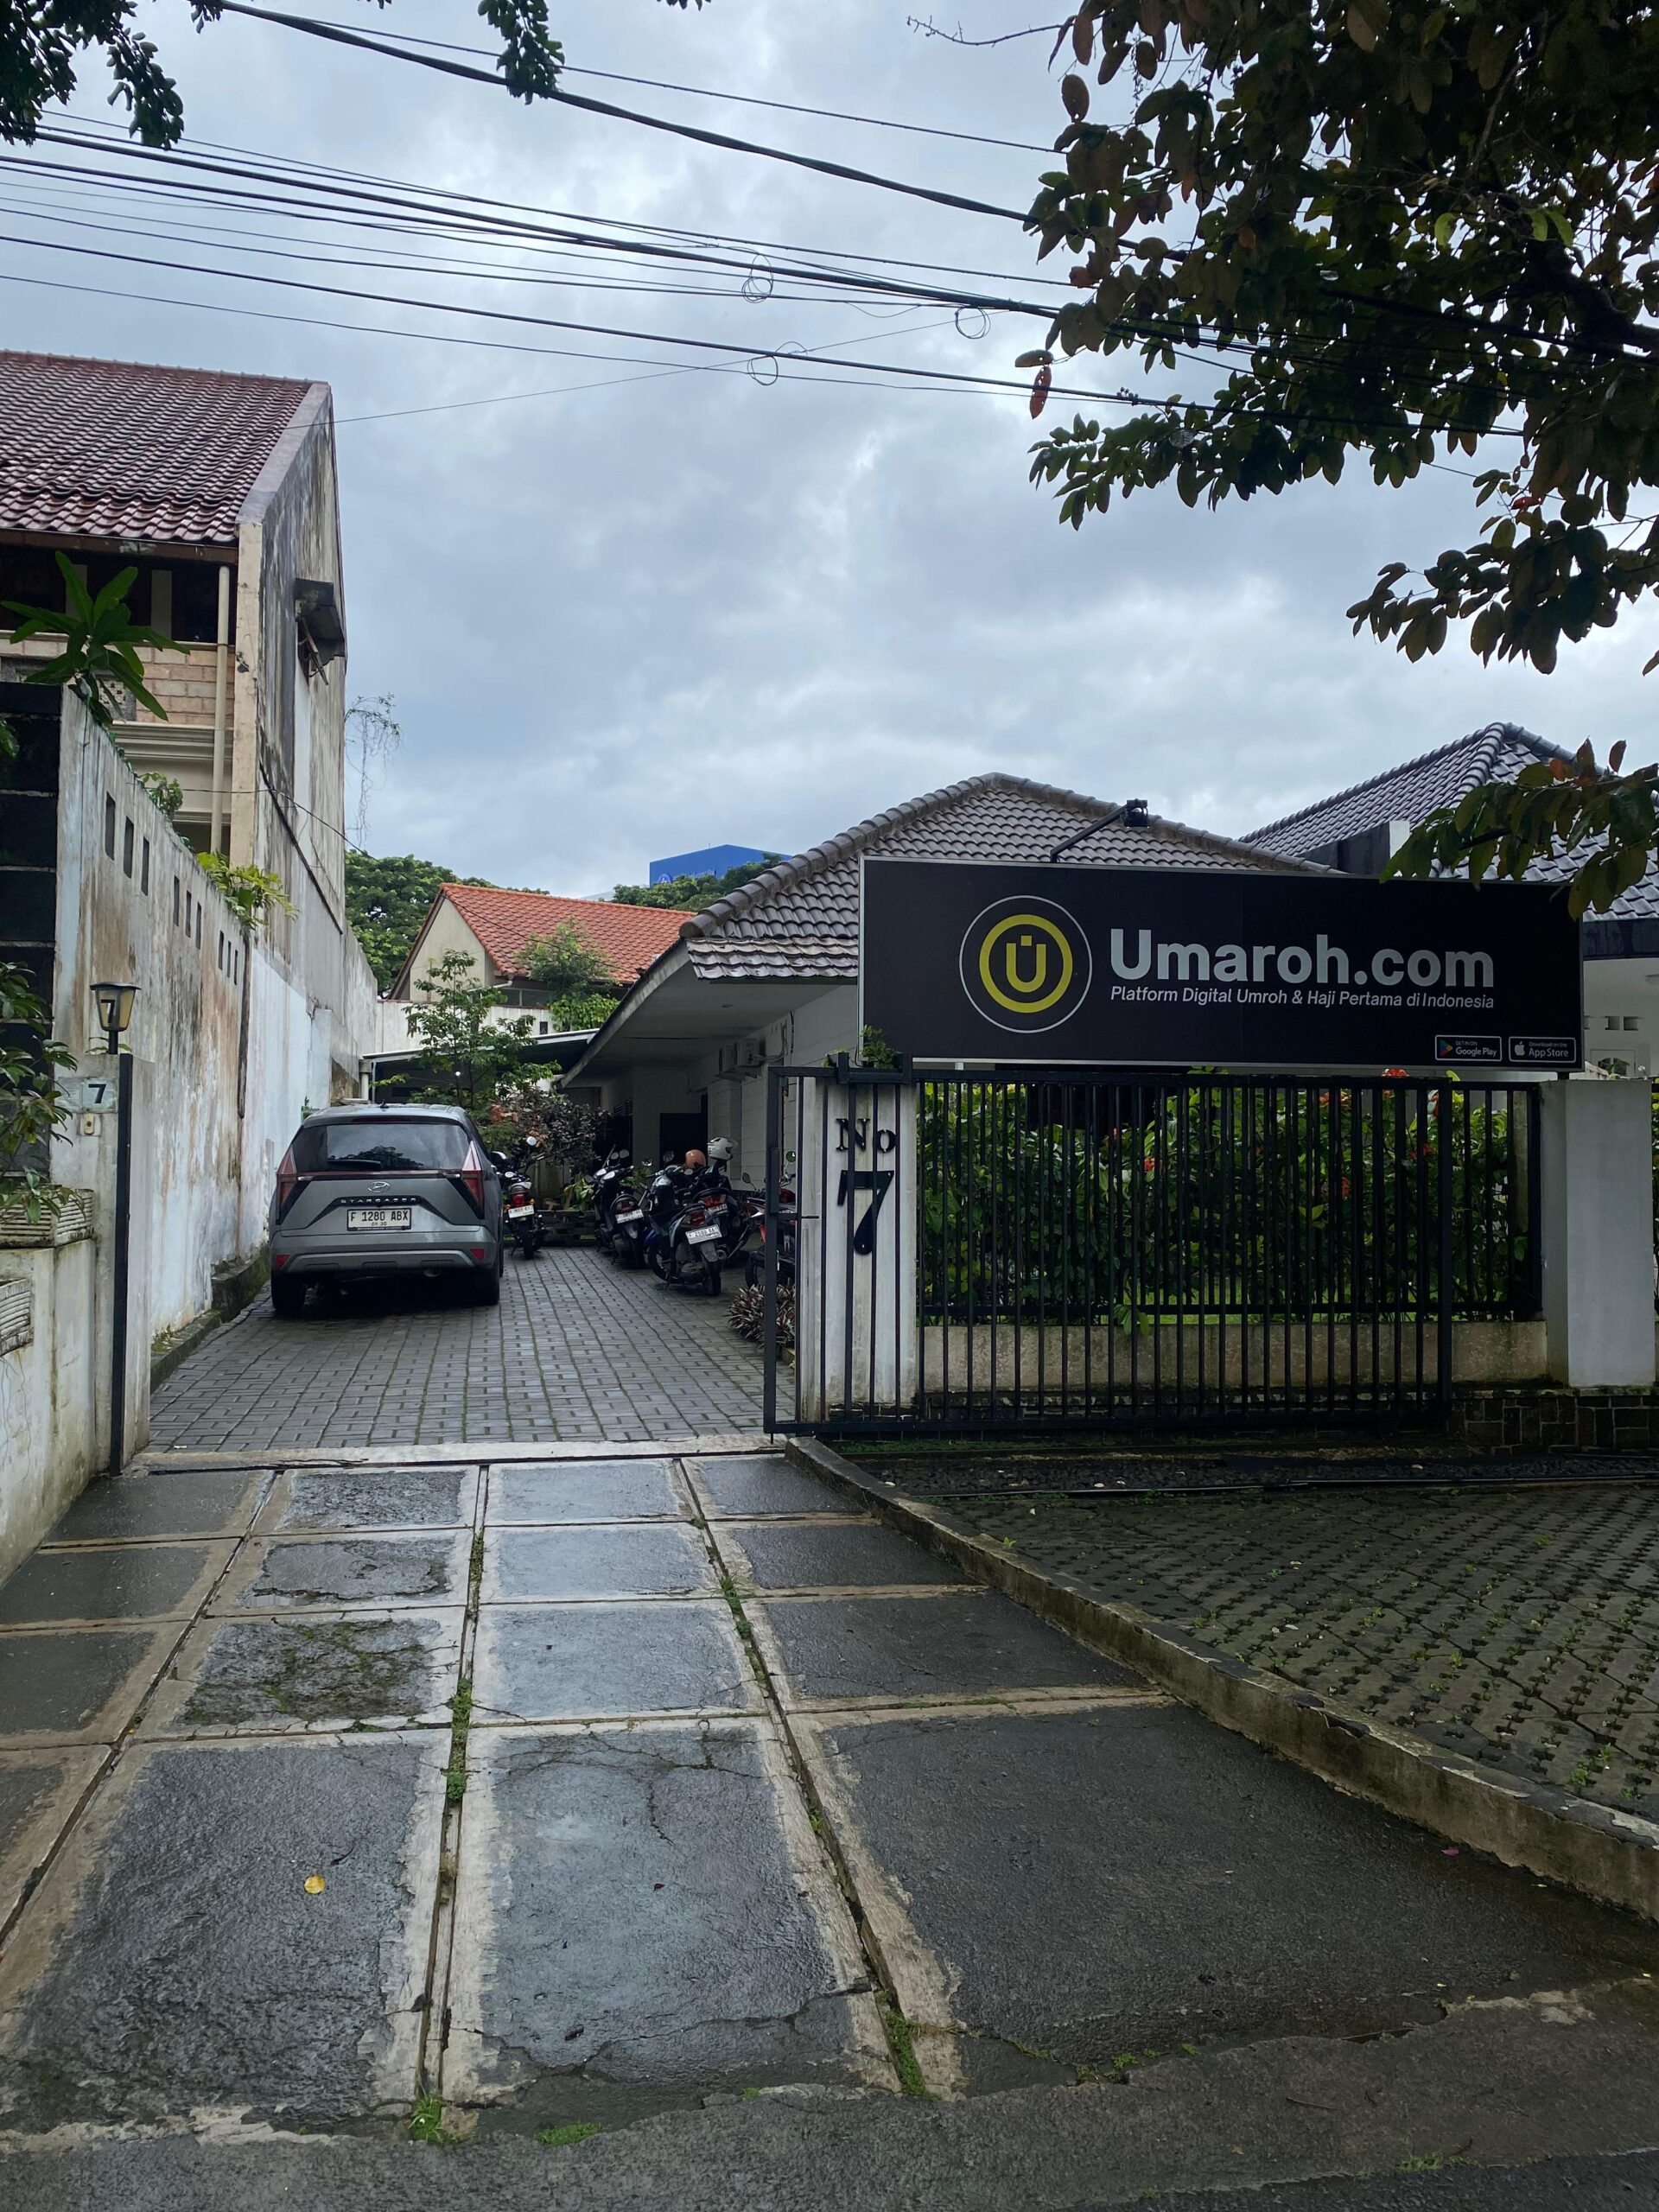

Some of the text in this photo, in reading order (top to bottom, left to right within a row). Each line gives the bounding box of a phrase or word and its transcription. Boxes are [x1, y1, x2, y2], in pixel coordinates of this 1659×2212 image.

[1110, 928, 1494, 988] Umaroh.com
[1110, 986, 1494, 1008] Platform Digital Umroh & Haji Pertama di Indonesia
[100, 1000, 115, 1023] 7
[1455, 1046, 1497, 1057] Google Play
[1529, 1048, 1568, 1058] App Store
[88, 1084, 106, 1103] 7
[836, 1118, 896, 1154] No
[351, 1211, 409, 1222] F 1280 ABX
[837, 1170, 894, 1255] 7
